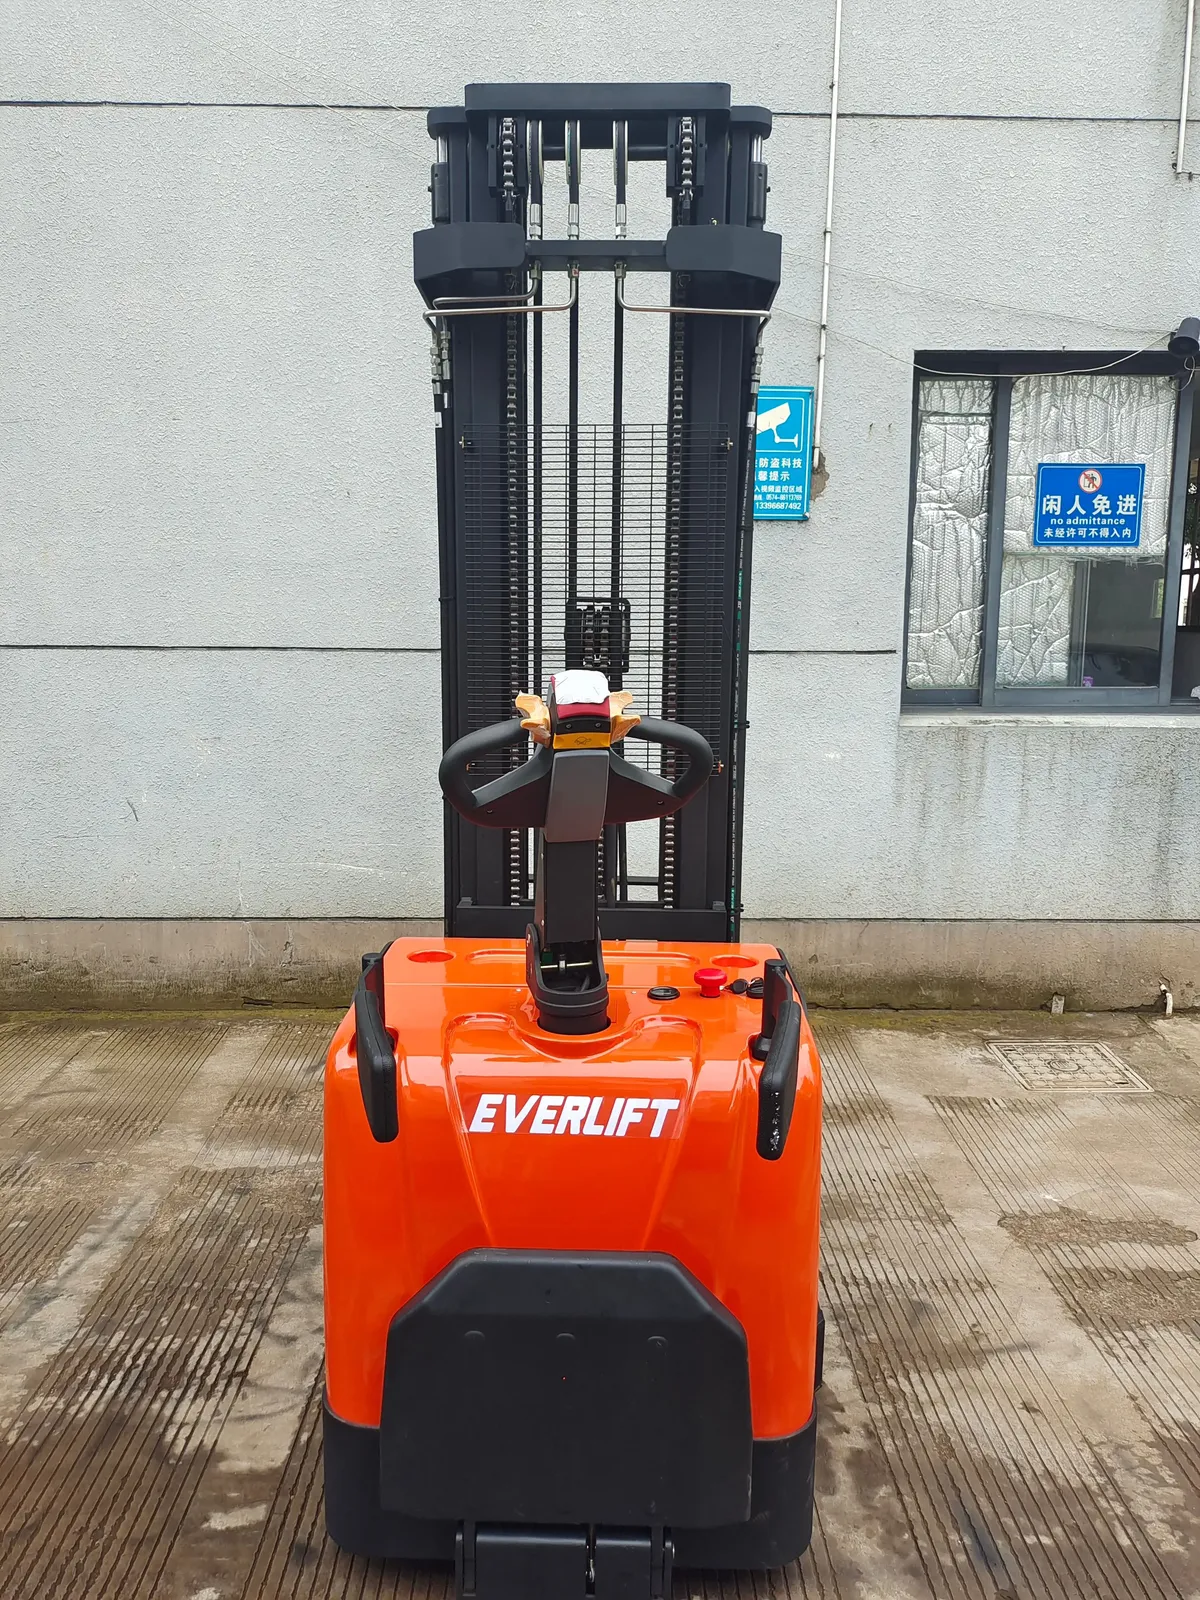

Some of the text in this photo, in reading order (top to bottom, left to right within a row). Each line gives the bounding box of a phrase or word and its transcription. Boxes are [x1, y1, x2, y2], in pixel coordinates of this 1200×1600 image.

[755, 457, 802, 469] 防盗科技
[755, 470, 790, 482] 馨提示
[1042, 494, 1137, 516] 闲人免进
[1066, 516, 1126, 525] admittance
[1043, 527, 1132, 538] 未经许可不得入内
[469, 1093, 681, 1138] EVERLIFT
